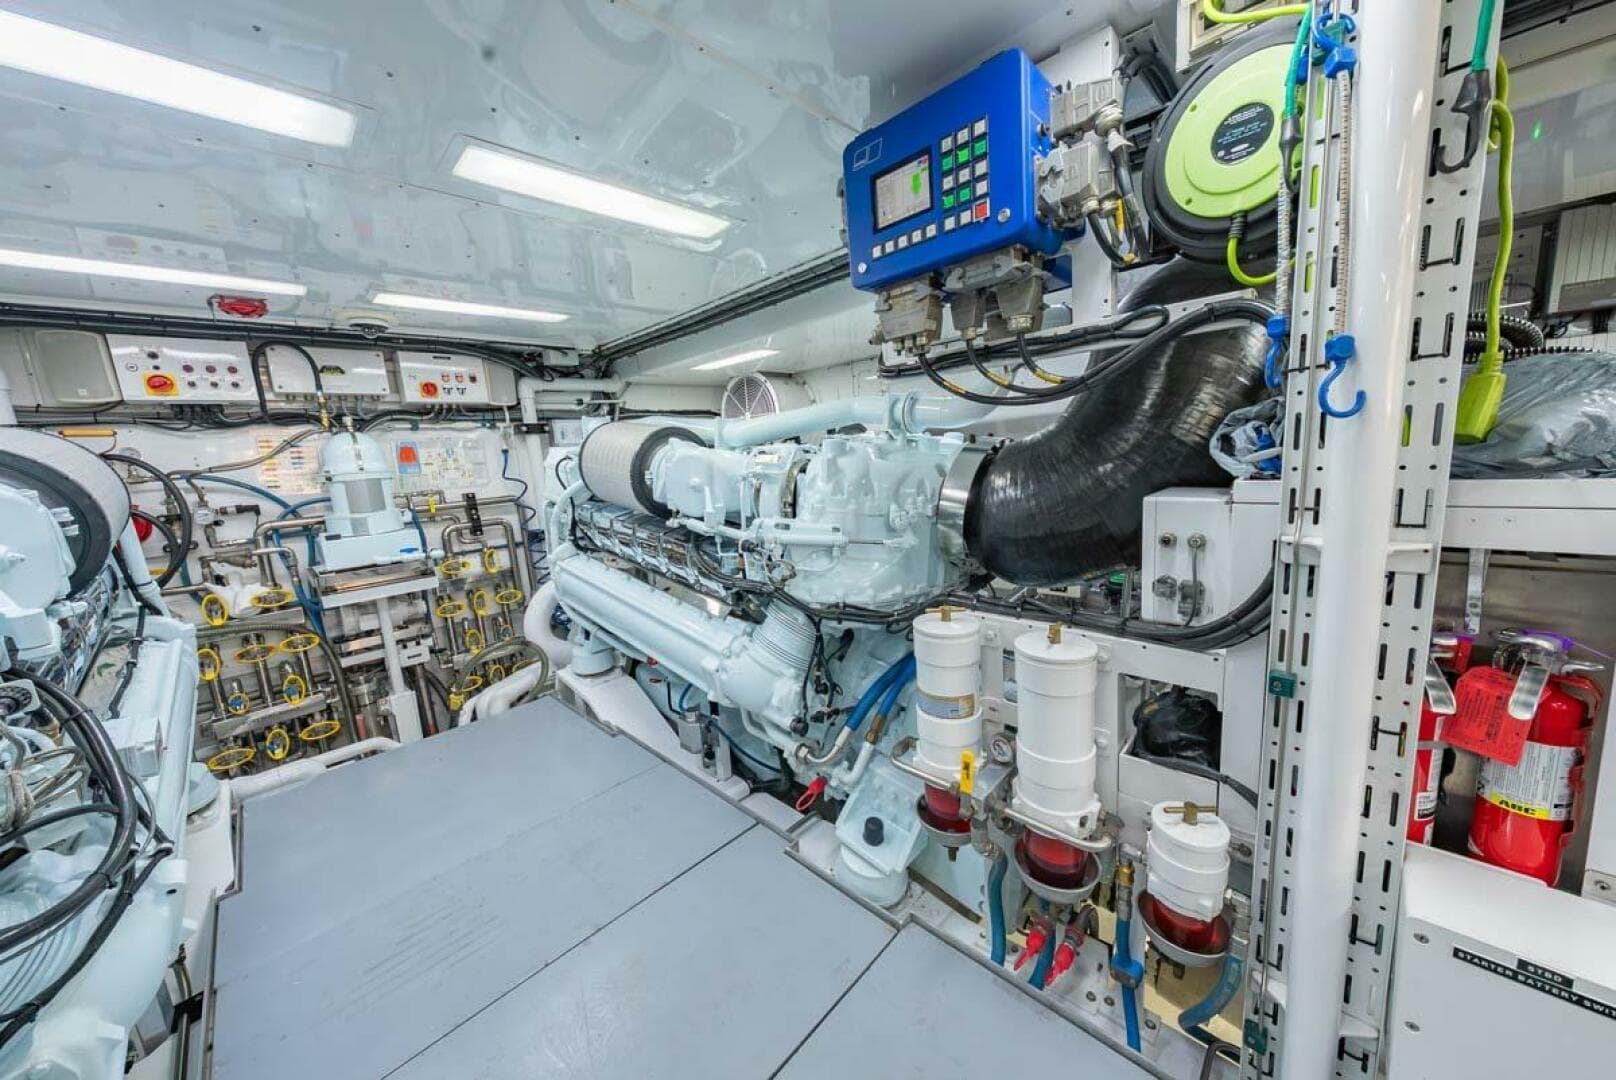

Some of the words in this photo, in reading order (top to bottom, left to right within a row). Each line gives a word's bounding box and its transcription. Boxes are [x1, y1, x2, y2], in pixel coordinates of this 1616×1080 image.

[1499, 799, 1537, 816] ABC
[1457, 951, 1514, 978] STARTER
[1517, 974, 1579, 1002] BATTERY
[1527, 964, 1563, 983] STBD
